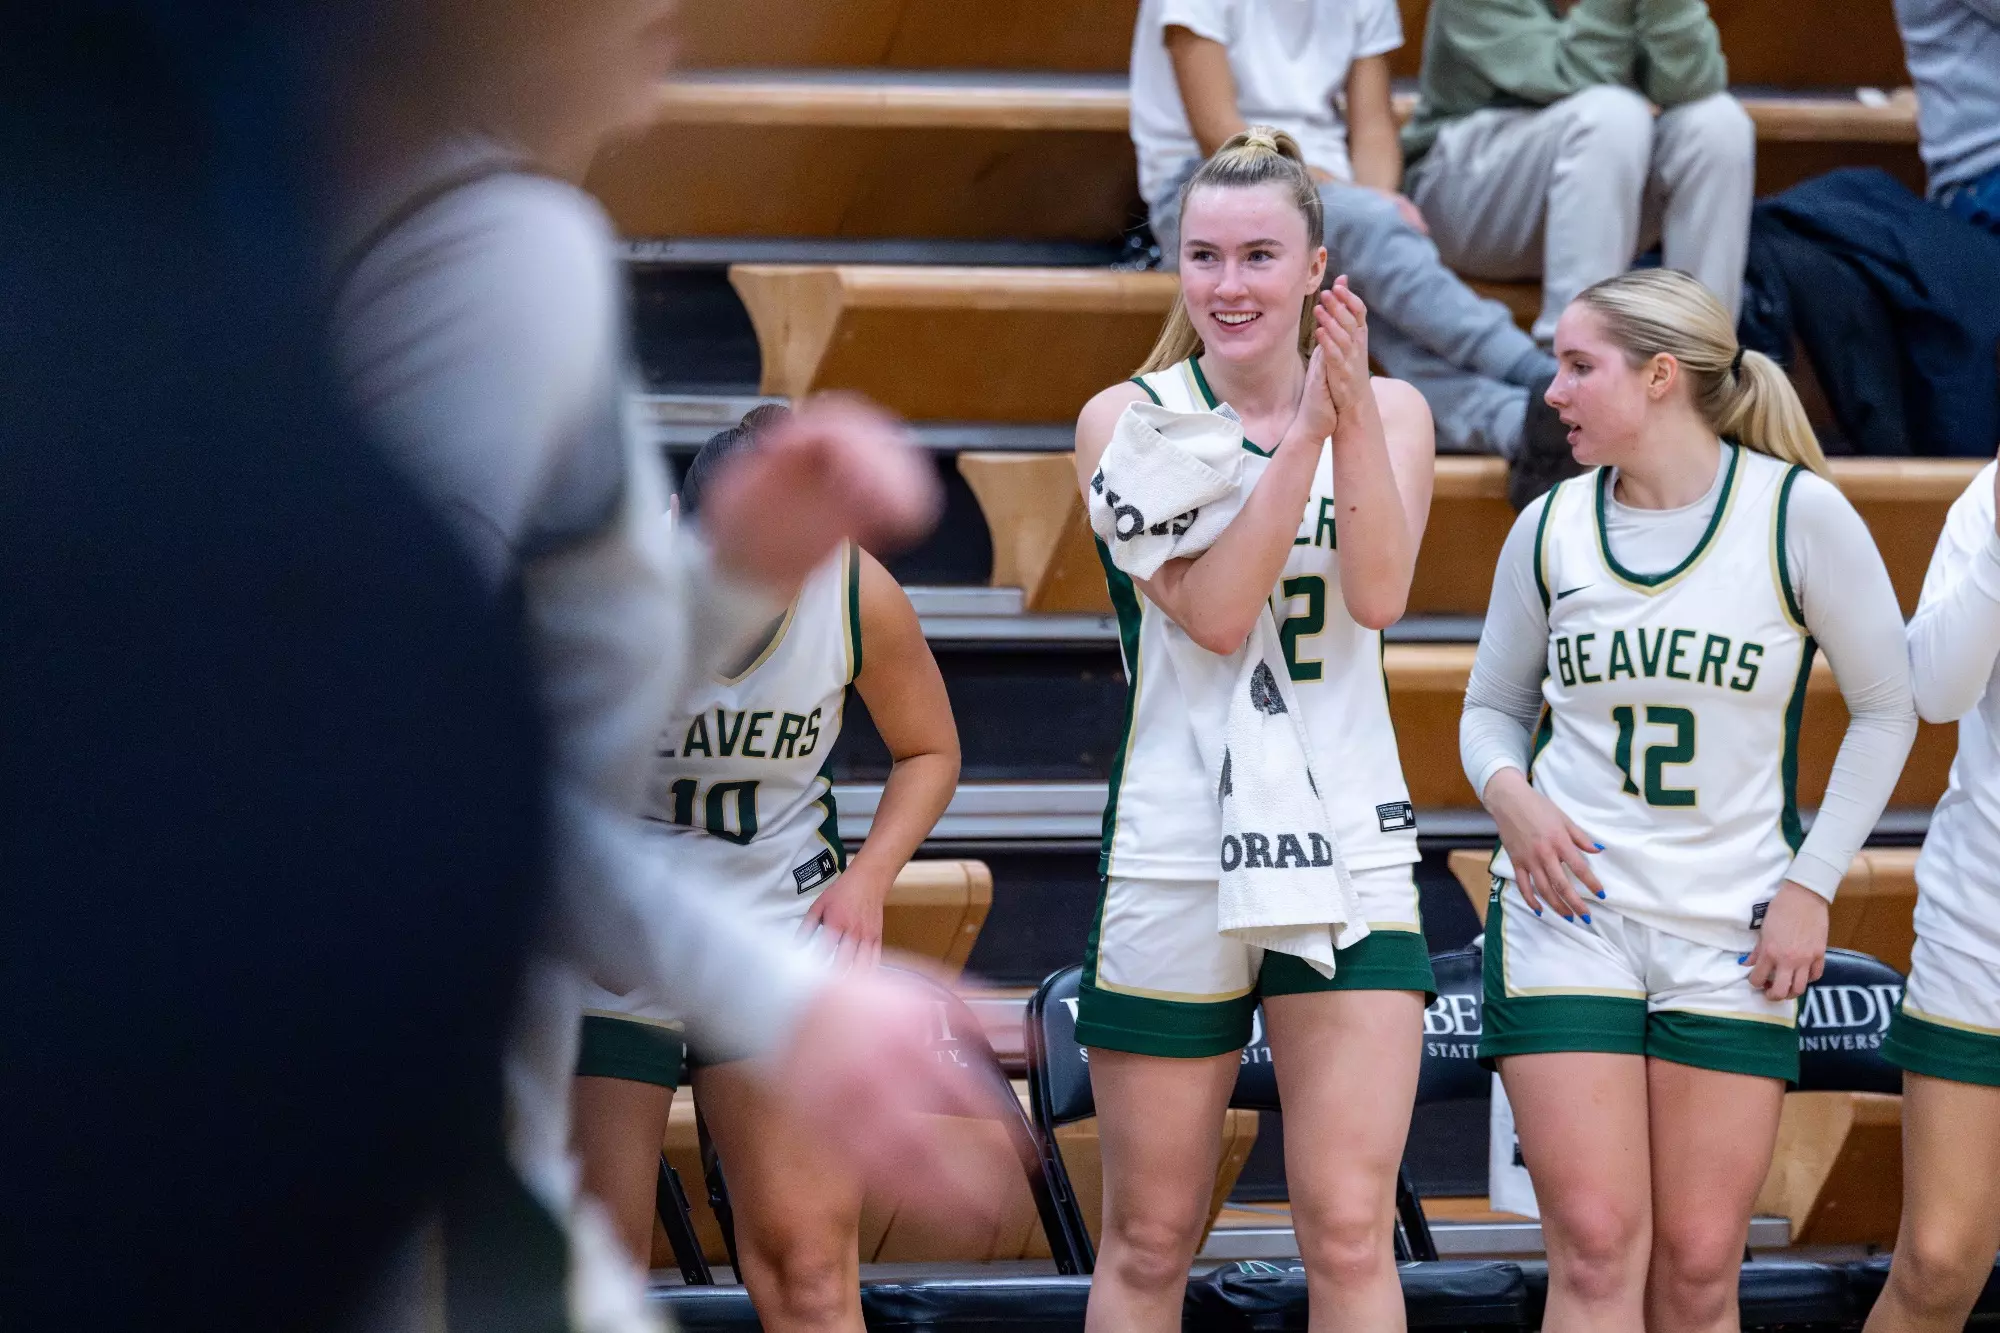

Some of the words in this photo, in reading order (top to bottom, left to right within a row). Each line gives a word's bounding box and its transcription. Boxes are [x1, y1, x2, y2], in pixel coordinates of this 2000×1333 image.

[1268, 573, 1329, 684] 2
[1556, 627, 1764, 692] BEAVERS
[1612, 704, 1697, 808] 12
[670, 777, 760, 845] 10
